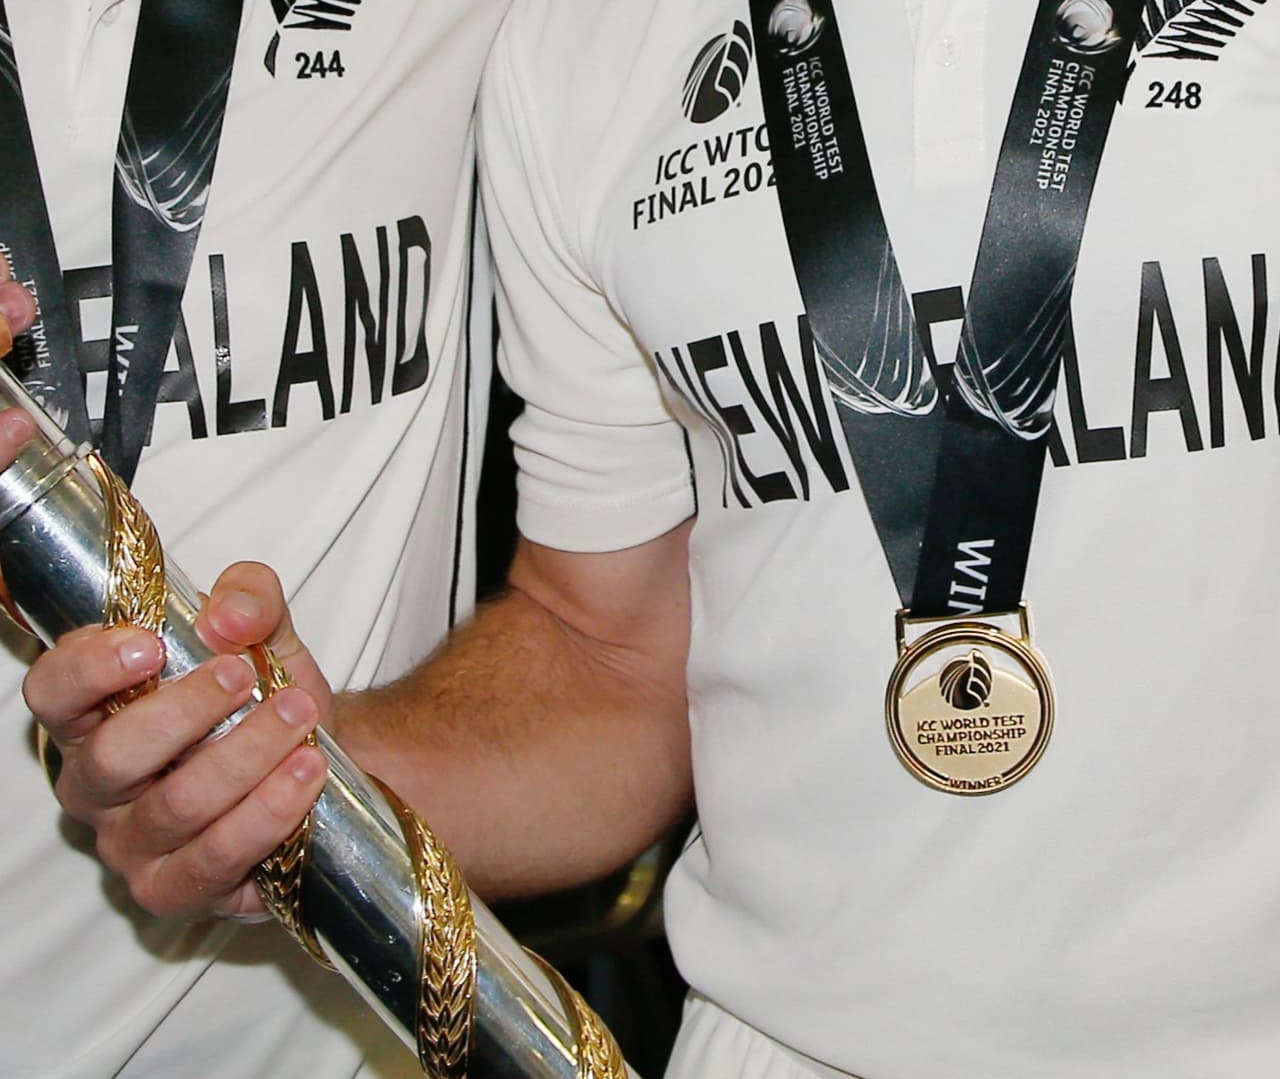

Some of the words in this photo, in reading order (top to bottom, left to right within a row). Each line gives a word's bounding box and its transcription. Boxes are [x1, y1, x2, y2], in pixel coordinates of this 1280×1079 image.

[295, 50, 345, 79] 244
[808, 56, 823, 78] ICC
[1040, 58, 1065, 105] FINAL
[1078, 64, 1096, 90] ICC
[782, 67, 800, 113] FINAL
[814, 81, 835, 136] WORLD
[1144, 80, 1202, 109] 248
[790, 113, 806, 150] 2021
[796, 62, 829, 180] CHAMPIONSHIP
[1029, 108, 1051, 145] 2021
[1036, 62, 1080, 190] CHAMPIONSHIP
[1061, 94, 1089, 151] WORLD
[655, 143, 698, 185] ICC
[825, 136, 844, 174] TEST
[1050, 153, 1073, 193] TEST
[633, 176, 716, 230] FINAL
[31, 320, 52, 368] FINAL
[654, 313, 850, 509] NEW
[917, 720, 937, 732] ICC
[940, 717, 990, 731] WORLD
[992, 715, 1025, 727] TEST
[917, 728, 1027, 745] CHAMPIONSHIP
[935, 744, 976, 756] FINAL
[977, 741, 1010, 754] 2021
[949, 776, 1001, 790] WINNER
